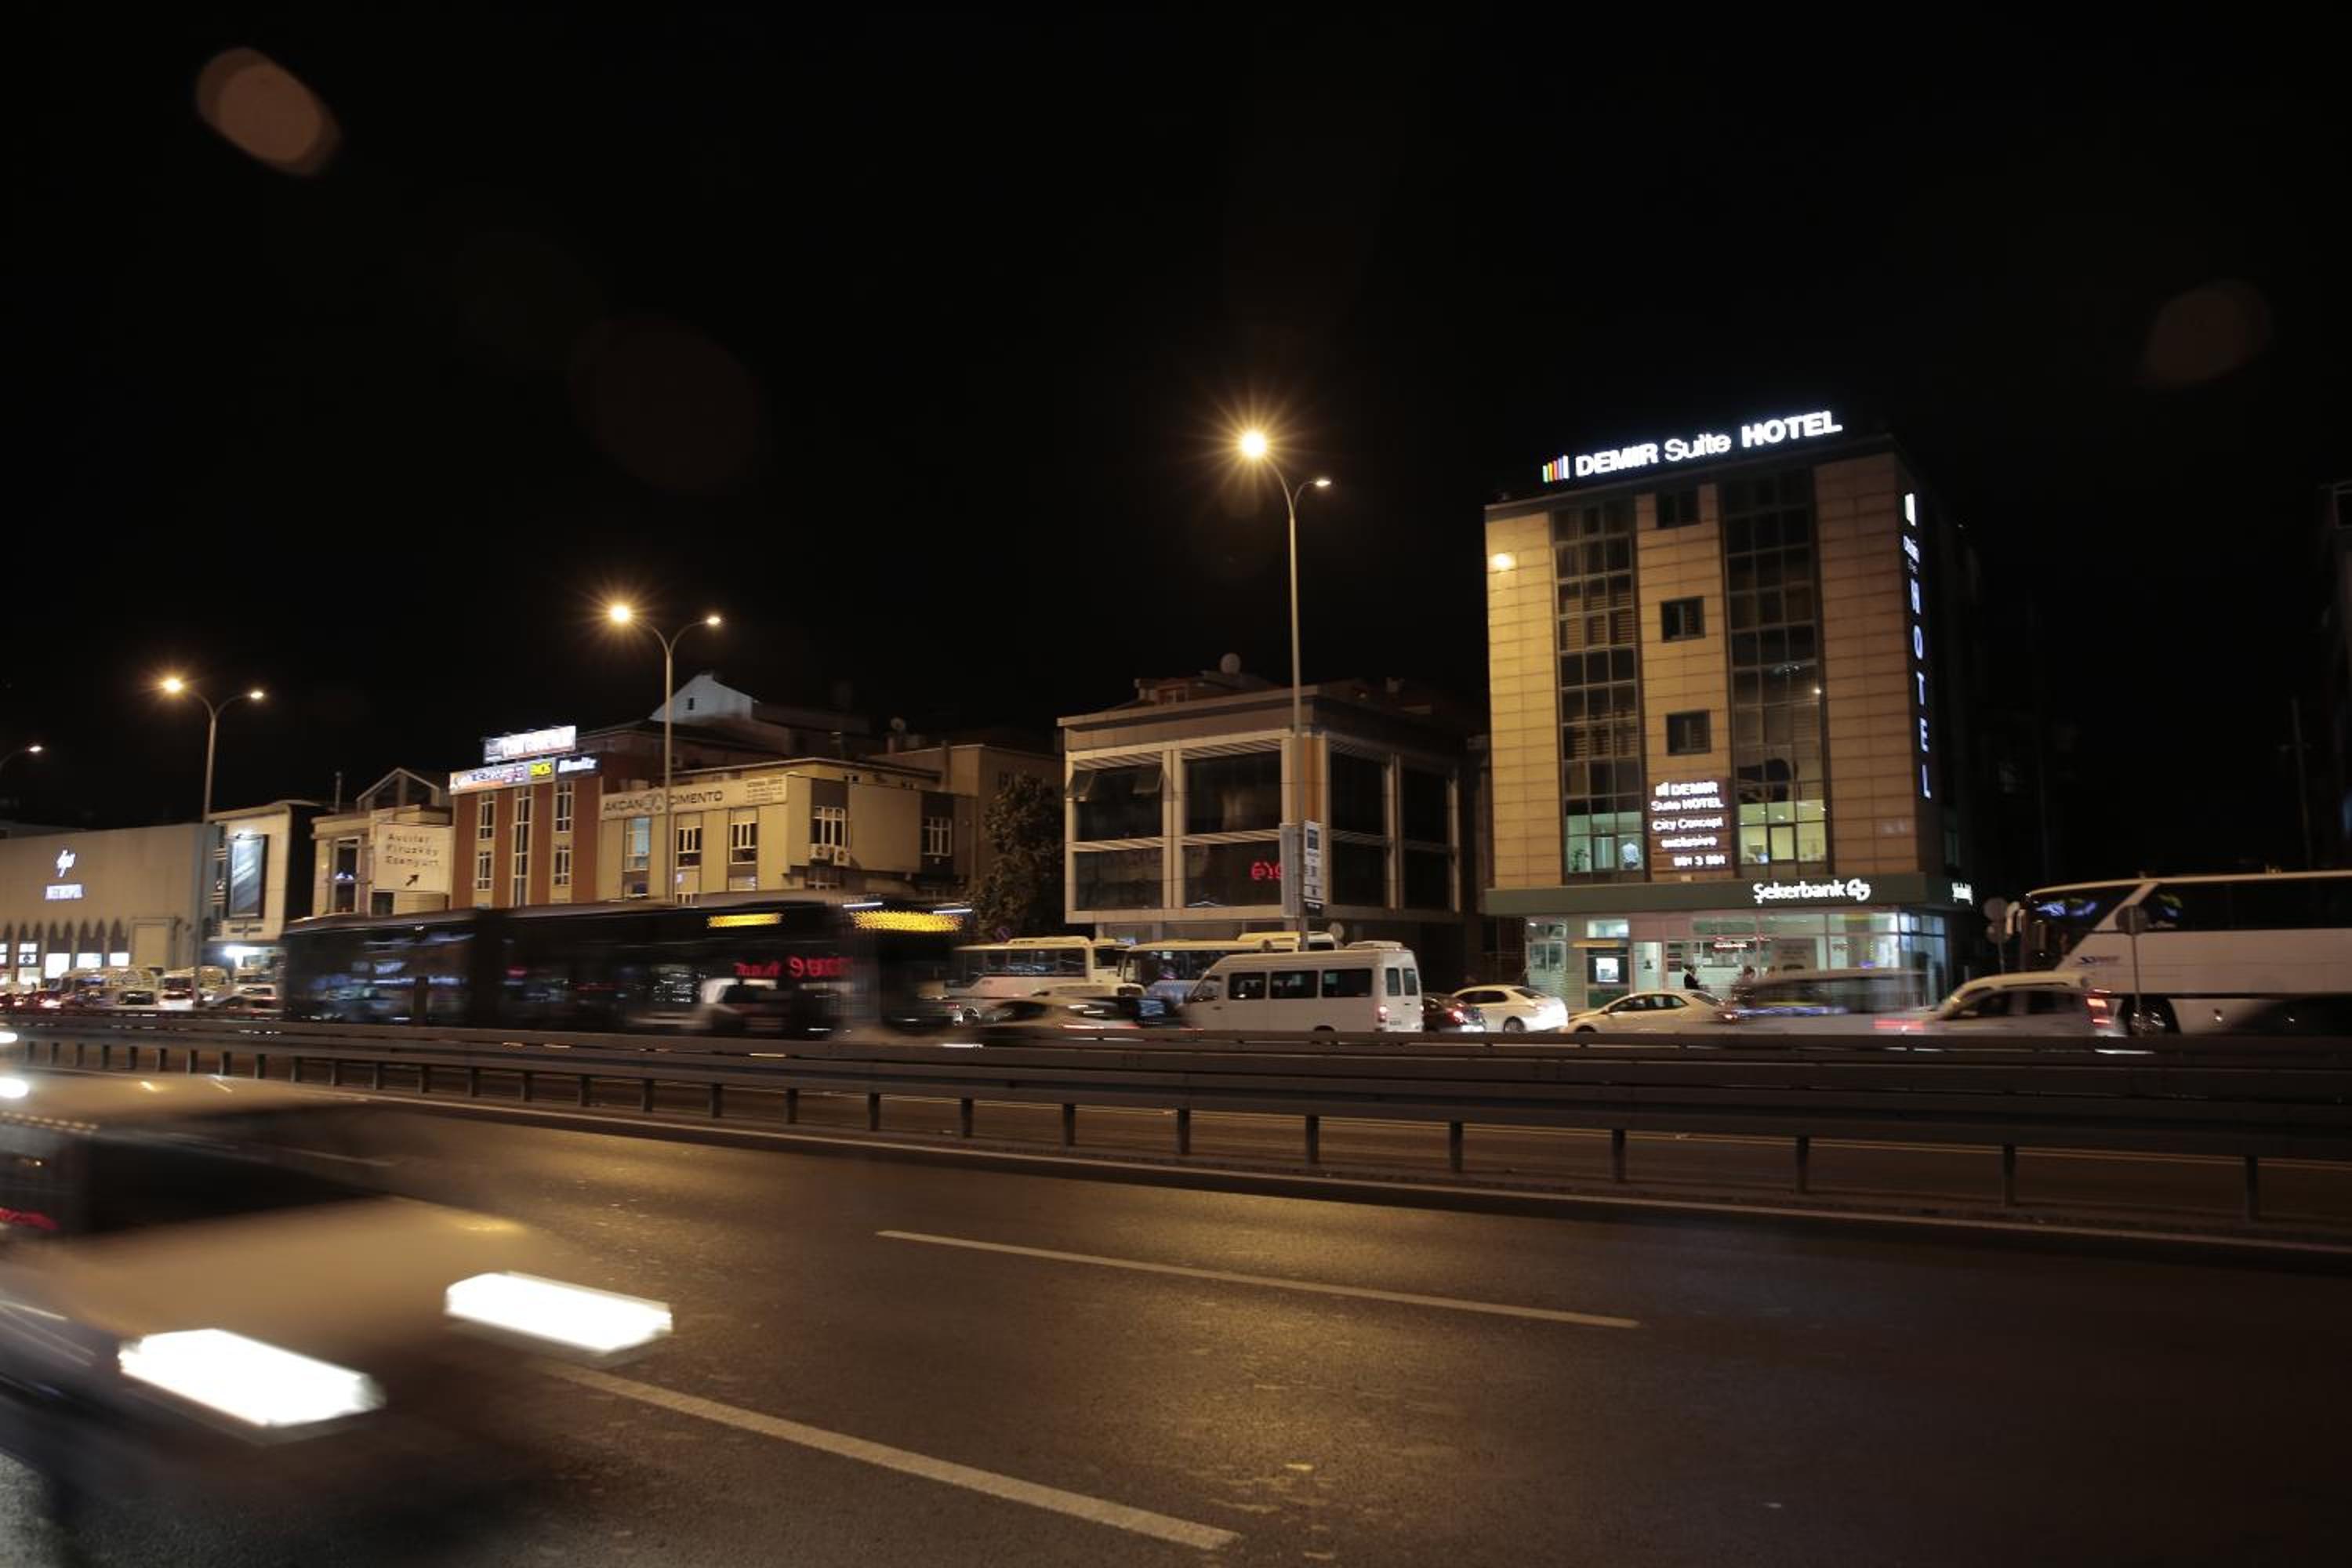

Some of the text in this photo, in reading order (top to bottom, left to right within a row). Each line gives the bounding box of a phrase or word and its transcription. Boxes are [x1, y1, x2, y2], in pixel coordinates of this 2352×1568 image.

[1575, 410, 1843, 477] DEMIR Suite HOTEL
[1682, 797, 1724, 810] HOTEL
[1752, 879, 1846, 904] Şekerbank
